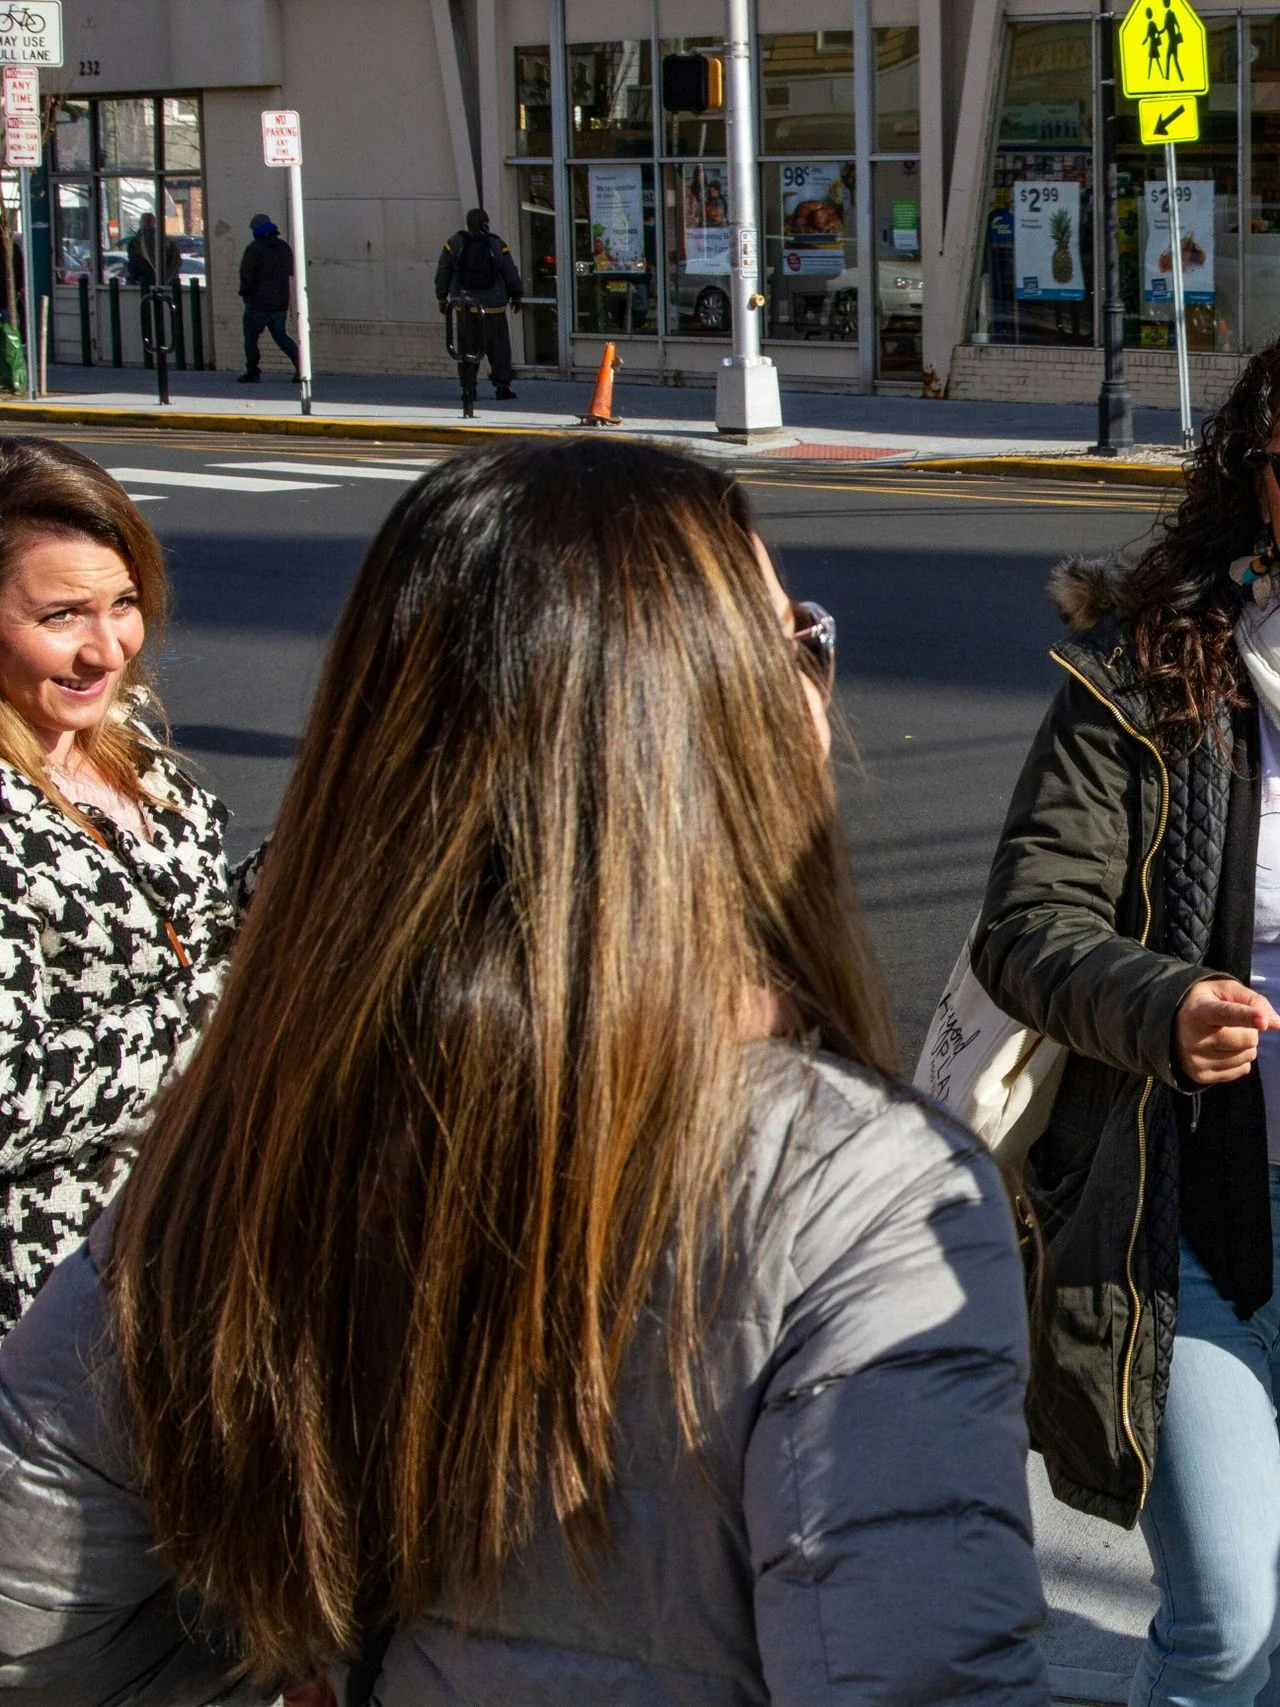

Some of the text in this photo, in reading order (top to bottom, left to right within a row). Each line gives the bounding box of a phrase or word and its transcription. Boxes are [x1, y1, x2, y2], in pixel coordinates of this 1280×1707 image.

[23, 36, 46, 47] USE
[22, 50, 51, 61] LANE
[79, 60, 101, 76] 232
[12, 81, 31, 90] ANY
[12, 93, 32, 103] TIME
[275, 115, 287, 125] NO
[265, 127, 297, 137] PARKING
